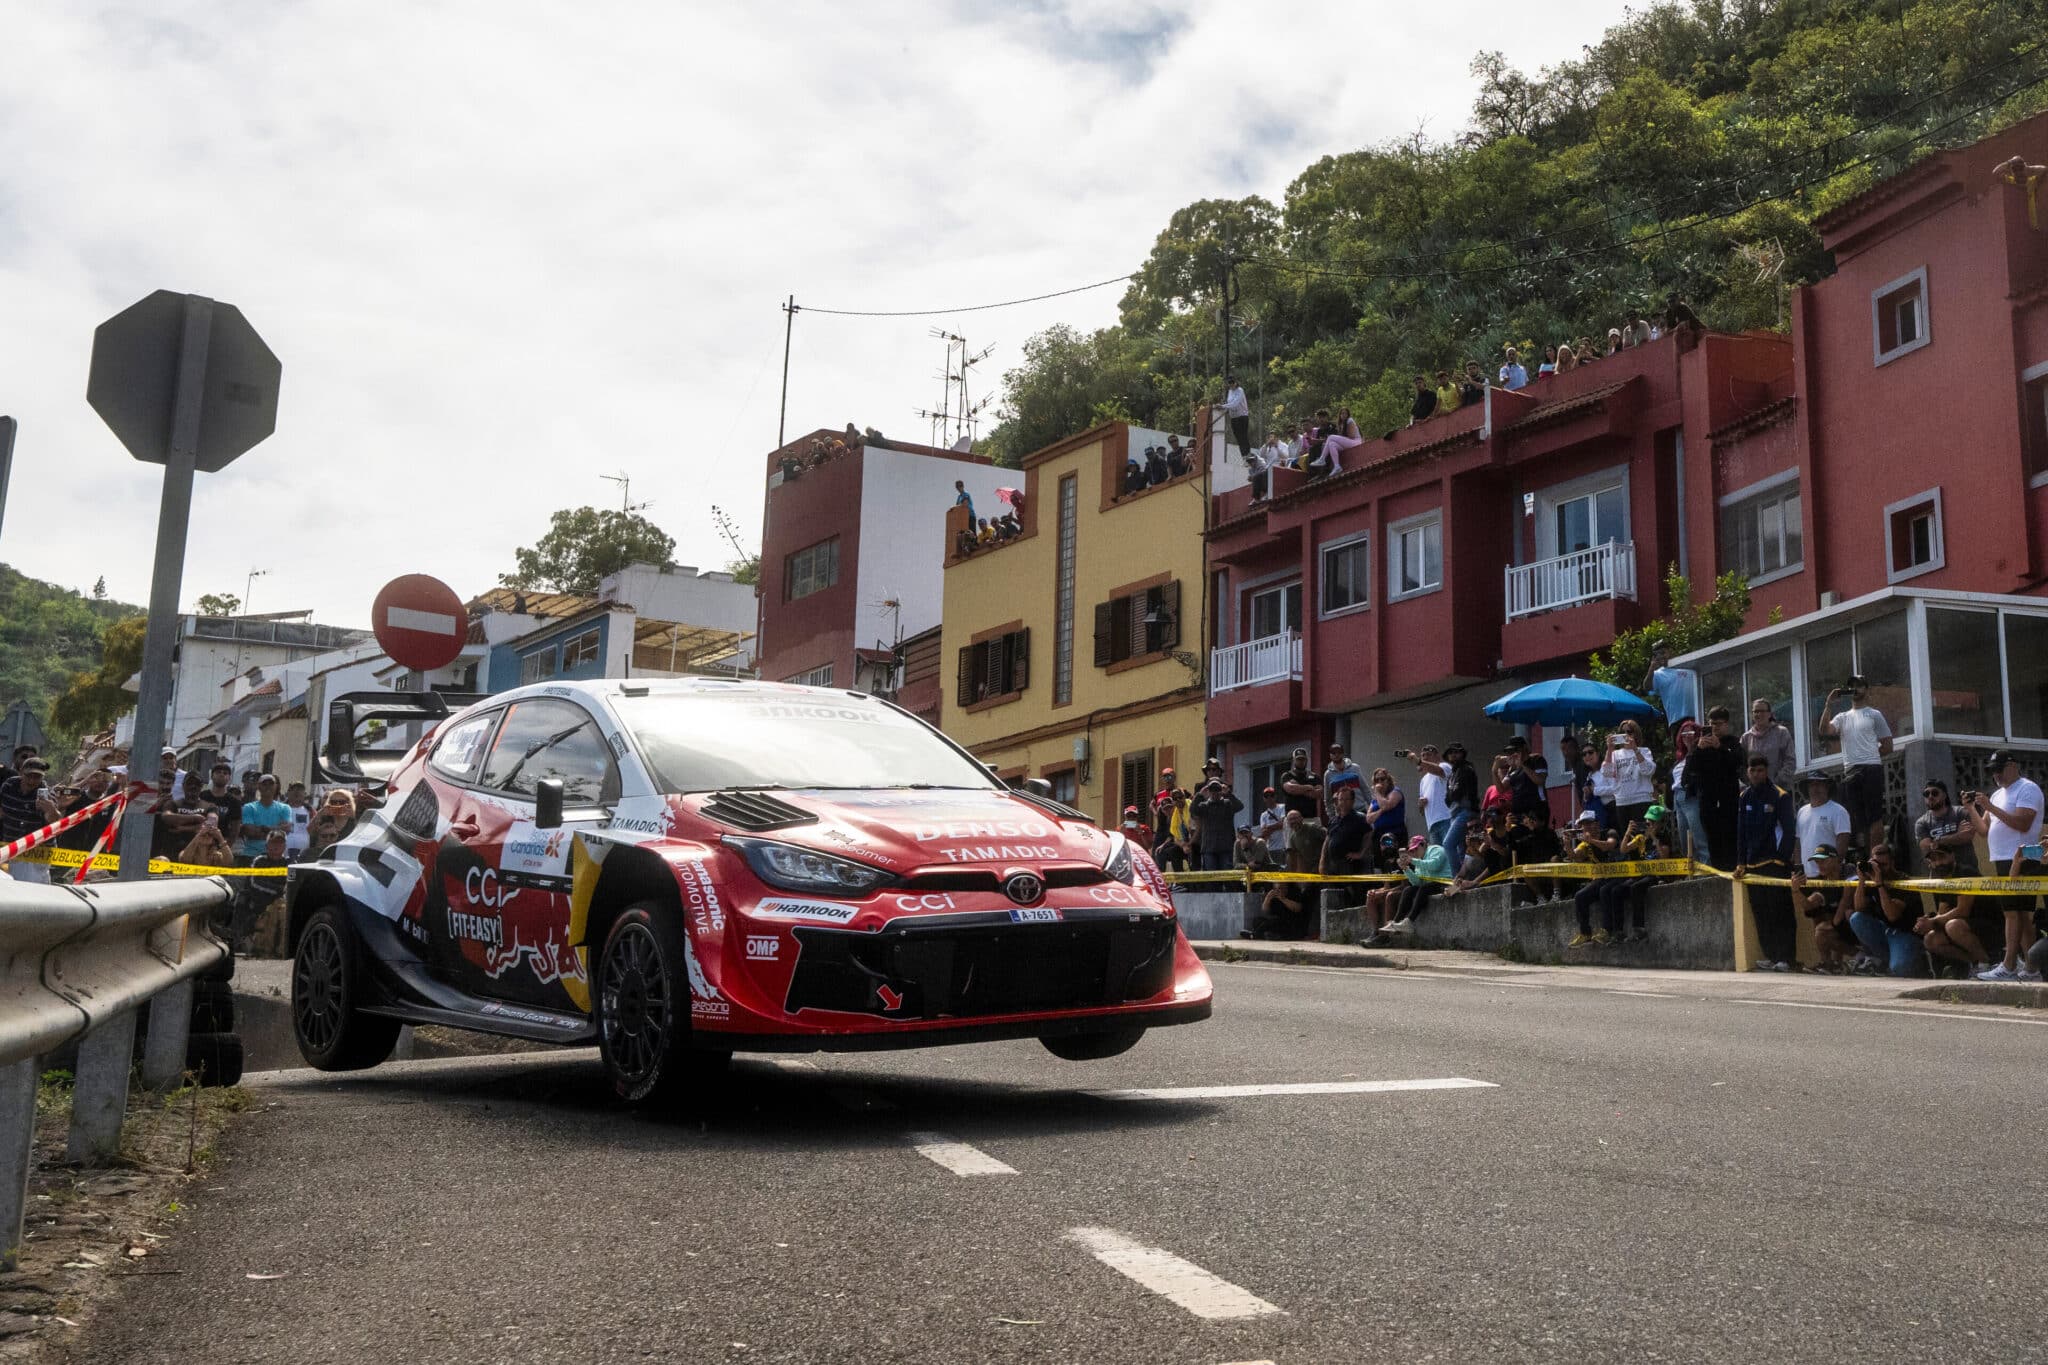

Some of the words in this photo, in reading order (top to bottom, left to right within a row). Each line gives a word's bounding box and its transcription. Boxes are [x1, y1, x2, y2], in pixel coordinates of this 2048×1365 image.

[613, 817, 658, 833] TAMADIC
[915, 822, 1048, 842] DENSO
[940, 845, 1060, 862] TAMADIC
[674, 861, 710, 935] UTOMOTIVE
[1021, 910, 1054, 921] A-7651
[746, 940, 780, 956] OMP
